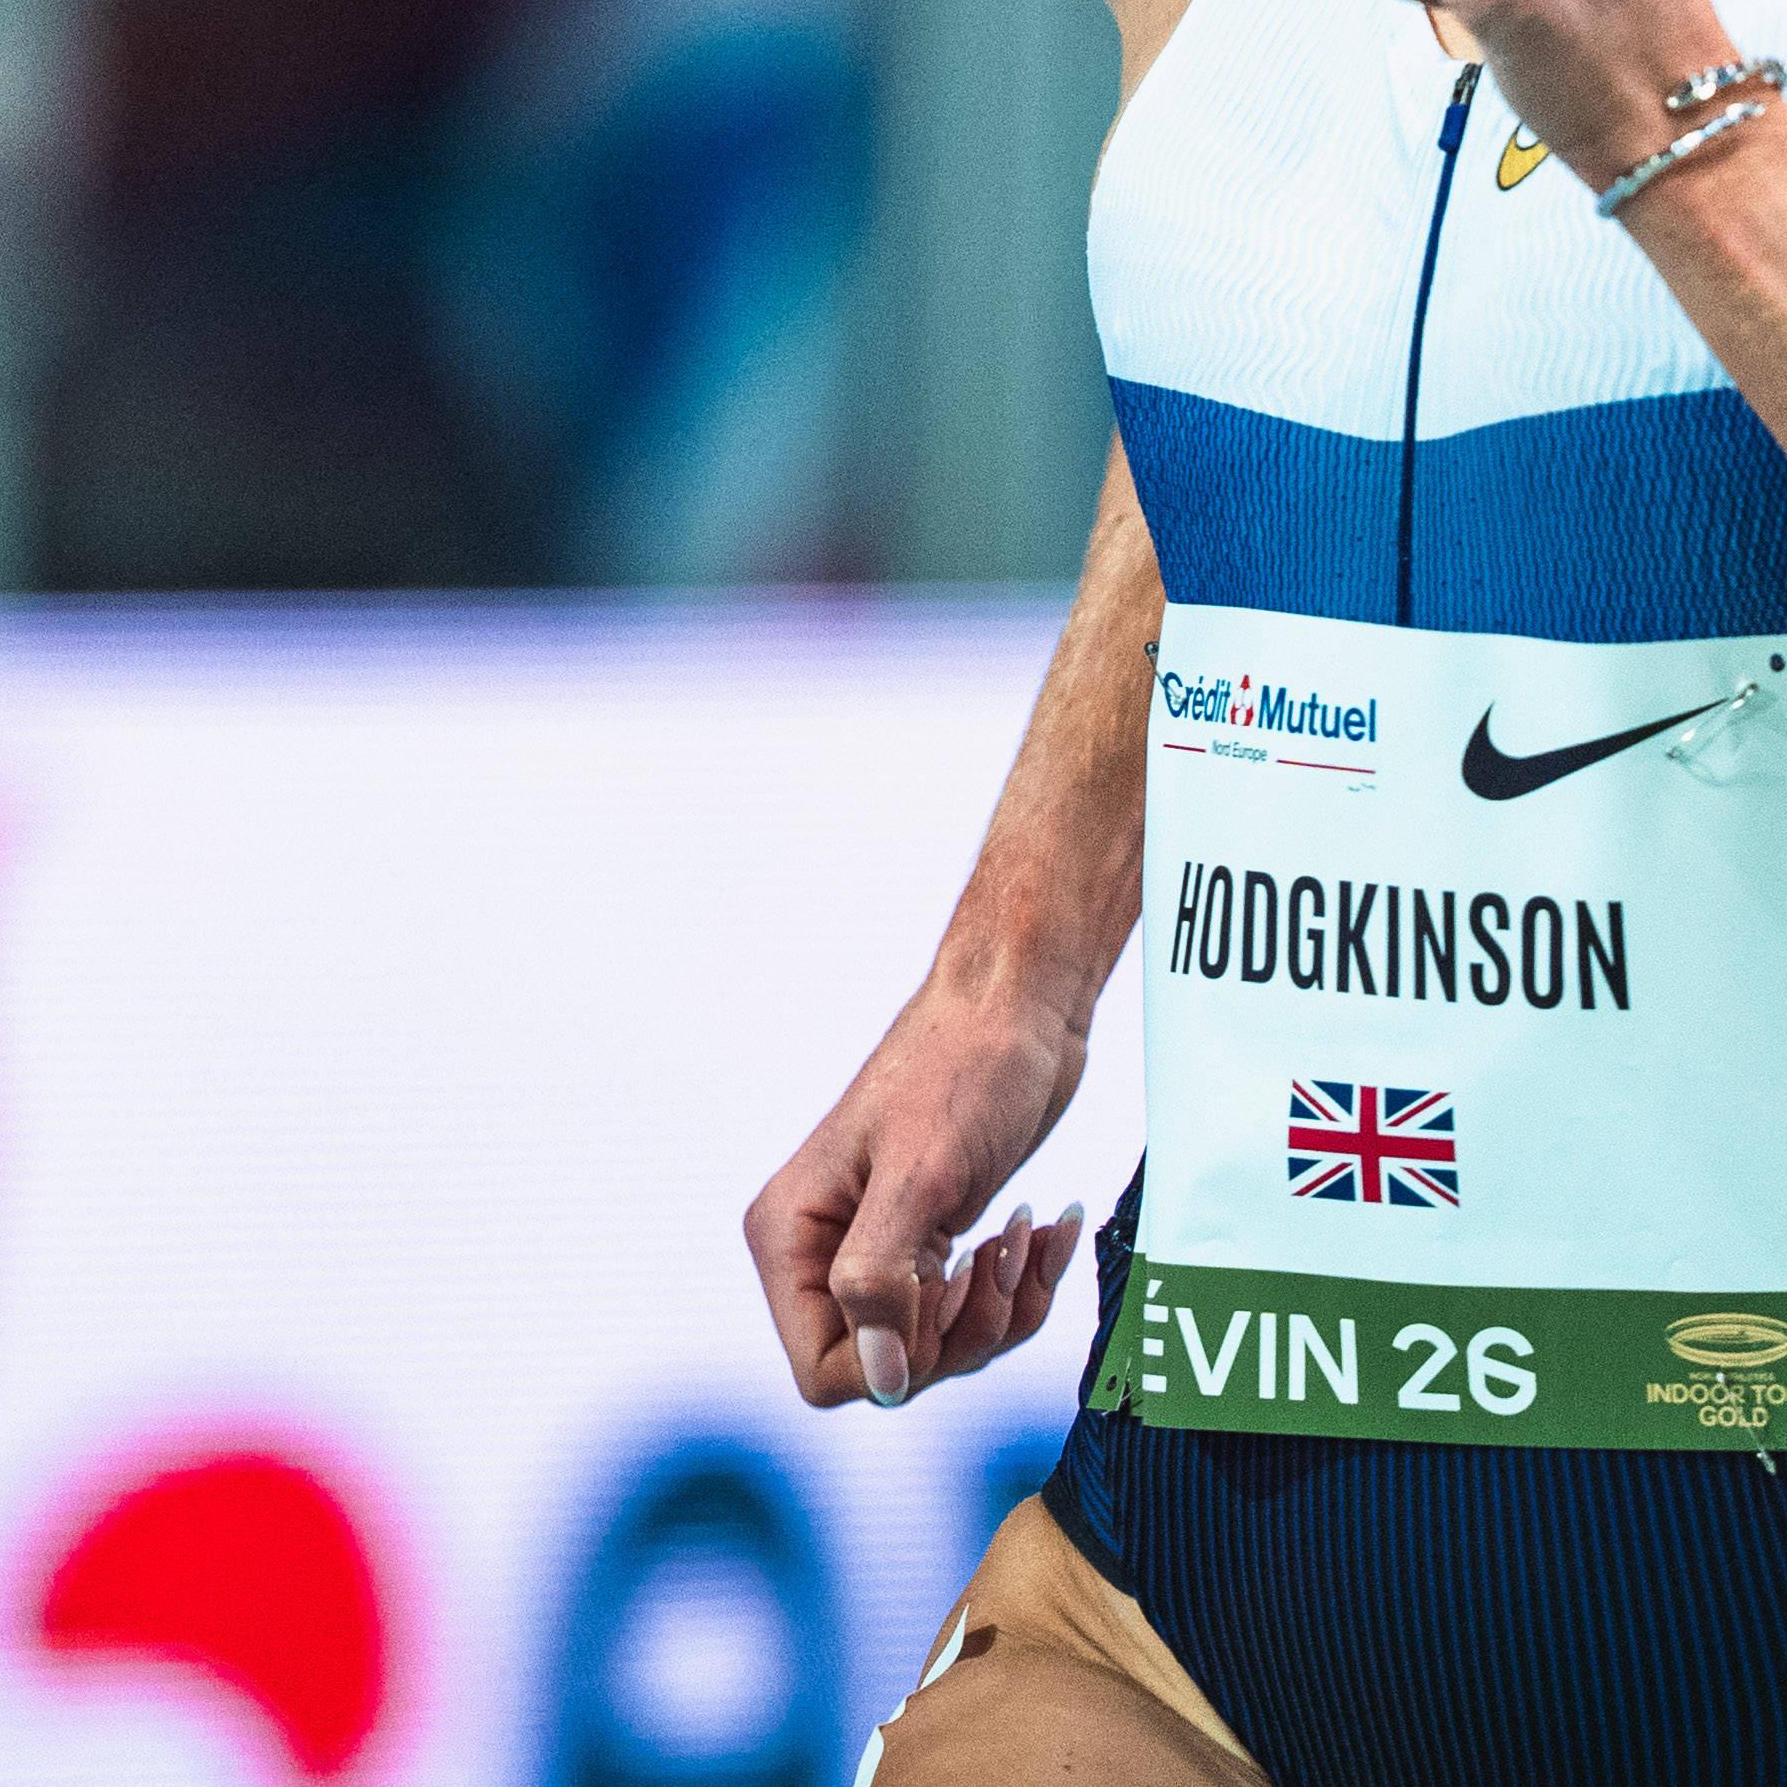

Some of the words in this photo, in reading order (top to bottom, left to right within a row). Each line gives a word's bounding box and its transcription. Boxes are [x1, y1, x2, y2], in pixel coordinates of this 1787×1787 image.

[1164, 671, 1231, 723] Crédit
[1257, 685, 1376, 743] Mutuel
[1232, 741, 1268, 763] Europe
[1170, 861, 1630, 1011] HODGKINSON
[1392, 1323, 1538, 1416] 26
[1645, 1382, 1745, 1404] INDOOR
[1698, 1405, 1769, 1428] GOLD
